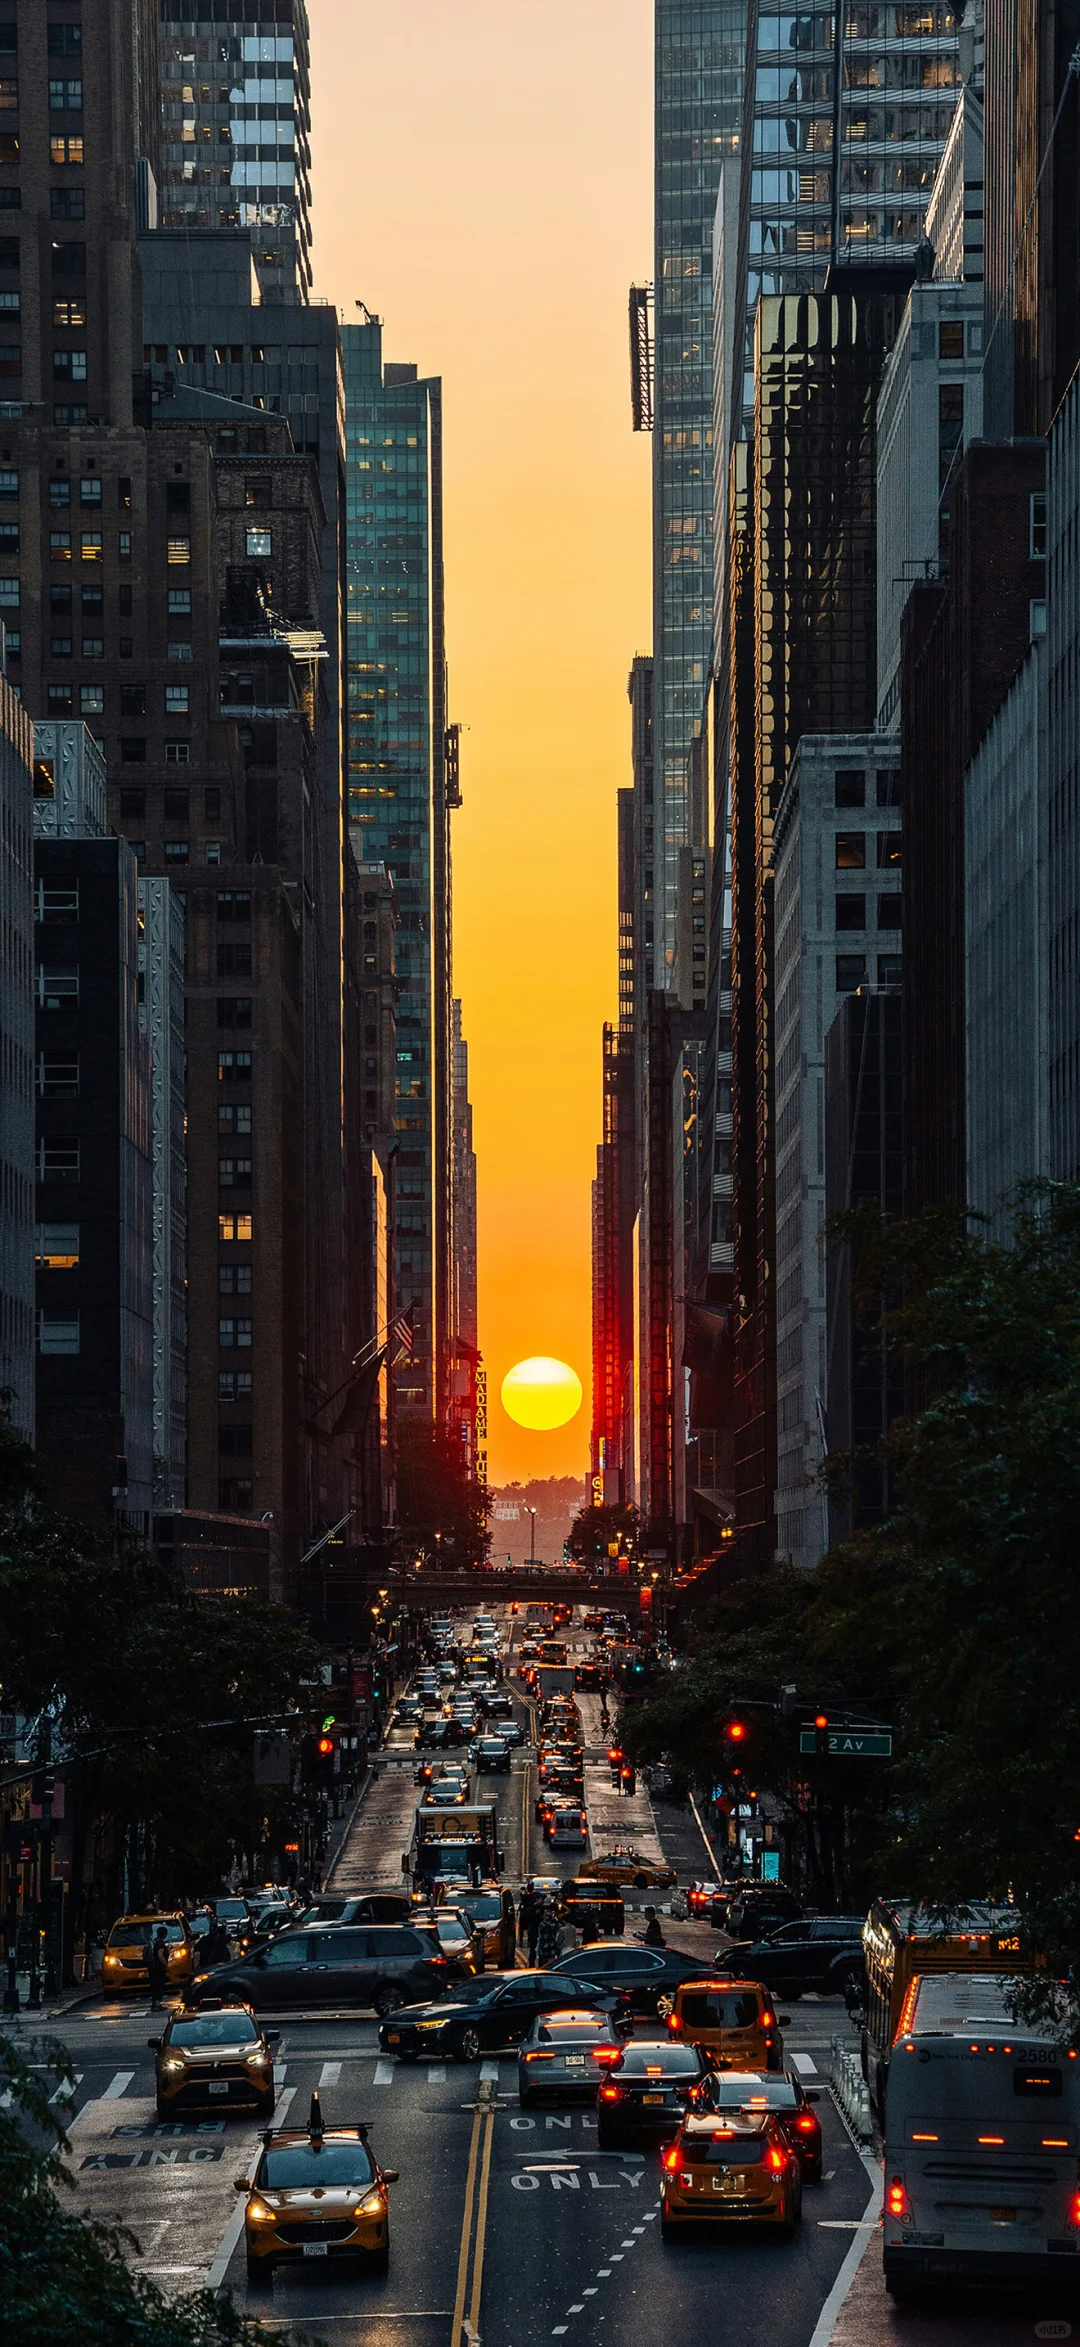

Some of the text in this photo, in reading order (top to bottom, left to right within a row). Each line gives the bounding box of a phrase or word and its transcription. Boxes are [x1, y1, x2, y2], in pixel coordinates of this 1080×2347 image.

[475, 1372, 486, 1438] MADAME
[828, 1737, 864, 1750] 2 Av
[1017, 2048, 1057, 2063] 2580
[113, 2120, 226, 2138] BUS
[509, 2115, 599, 2130] ONL
[78, 2147, 216, 2171] ONLY
[510, 2171, 645, 2190] ONLY
